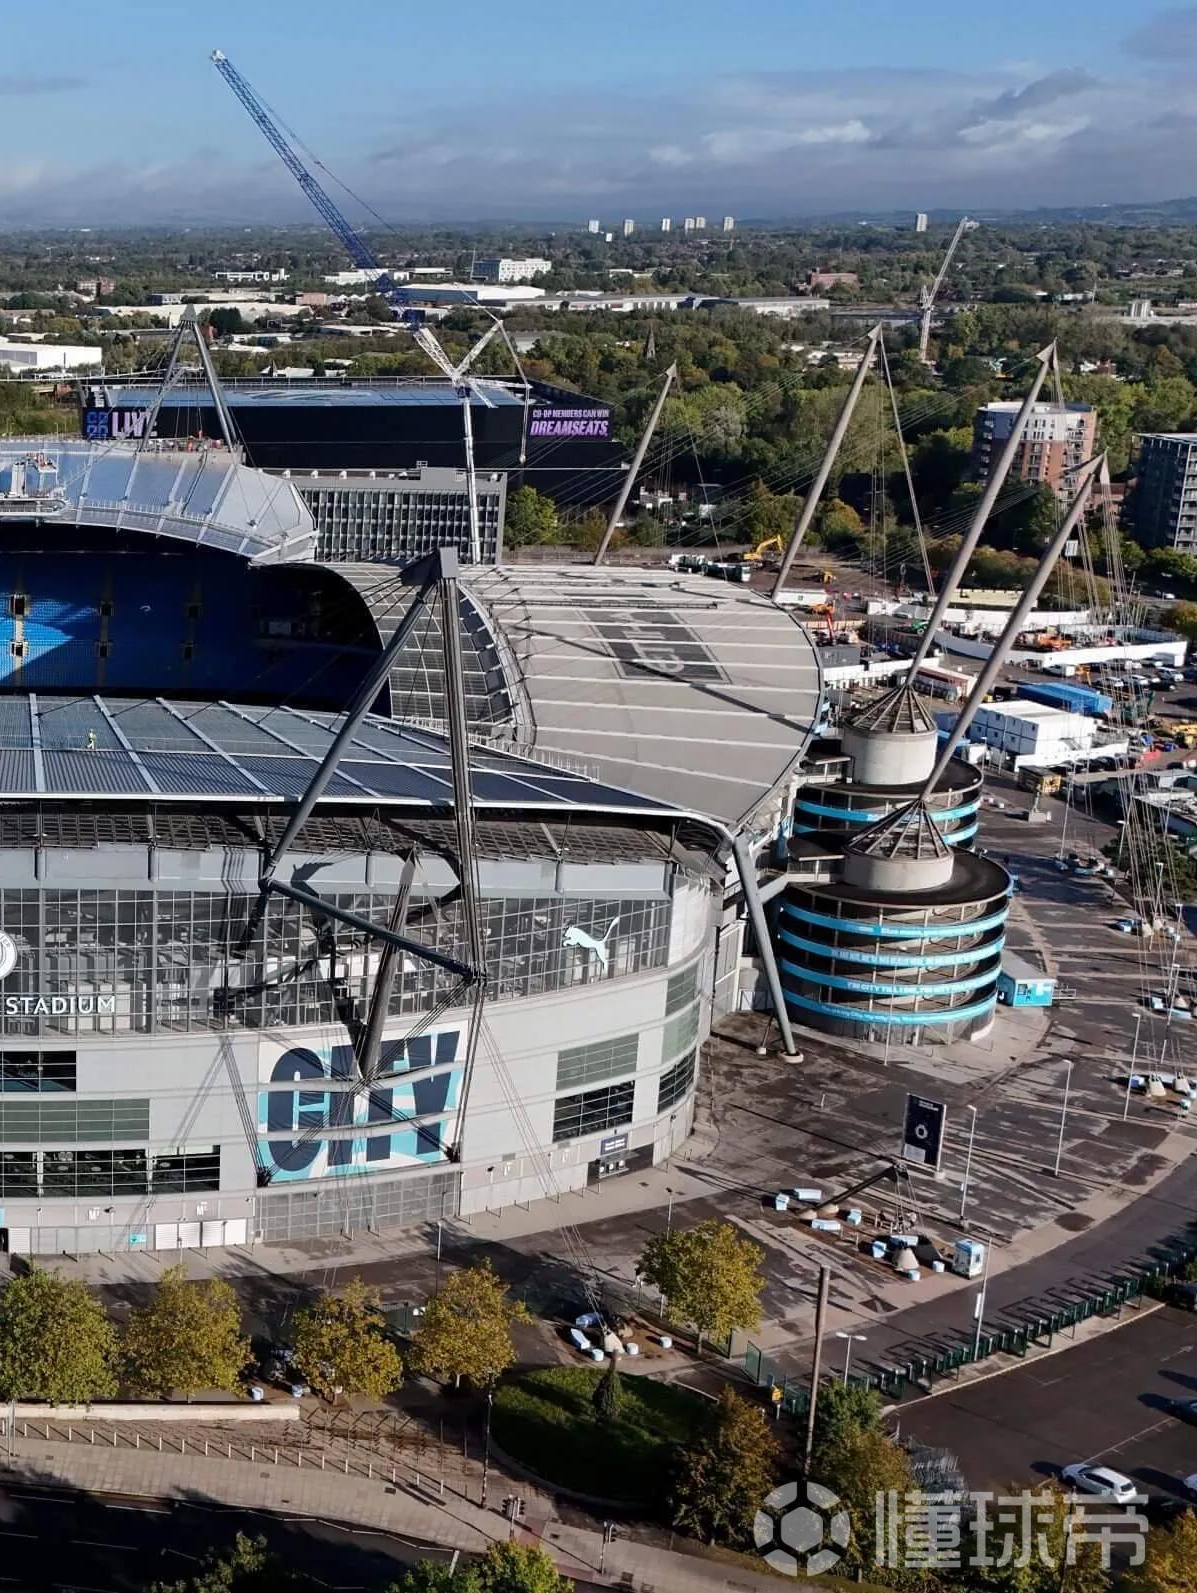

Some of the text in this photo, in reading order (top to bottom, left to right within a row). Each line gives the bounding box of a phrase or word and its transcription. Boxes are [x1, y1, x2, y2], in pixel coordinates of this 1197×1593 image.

[552, 409, 582, 418] MEMBERS
[583, 409, 596, 418] CAN
[597, 409, 610, 418] WIN
[6, 996, 115, 1015] STADIUM
[268, 1030, 460, 1171] CITY
